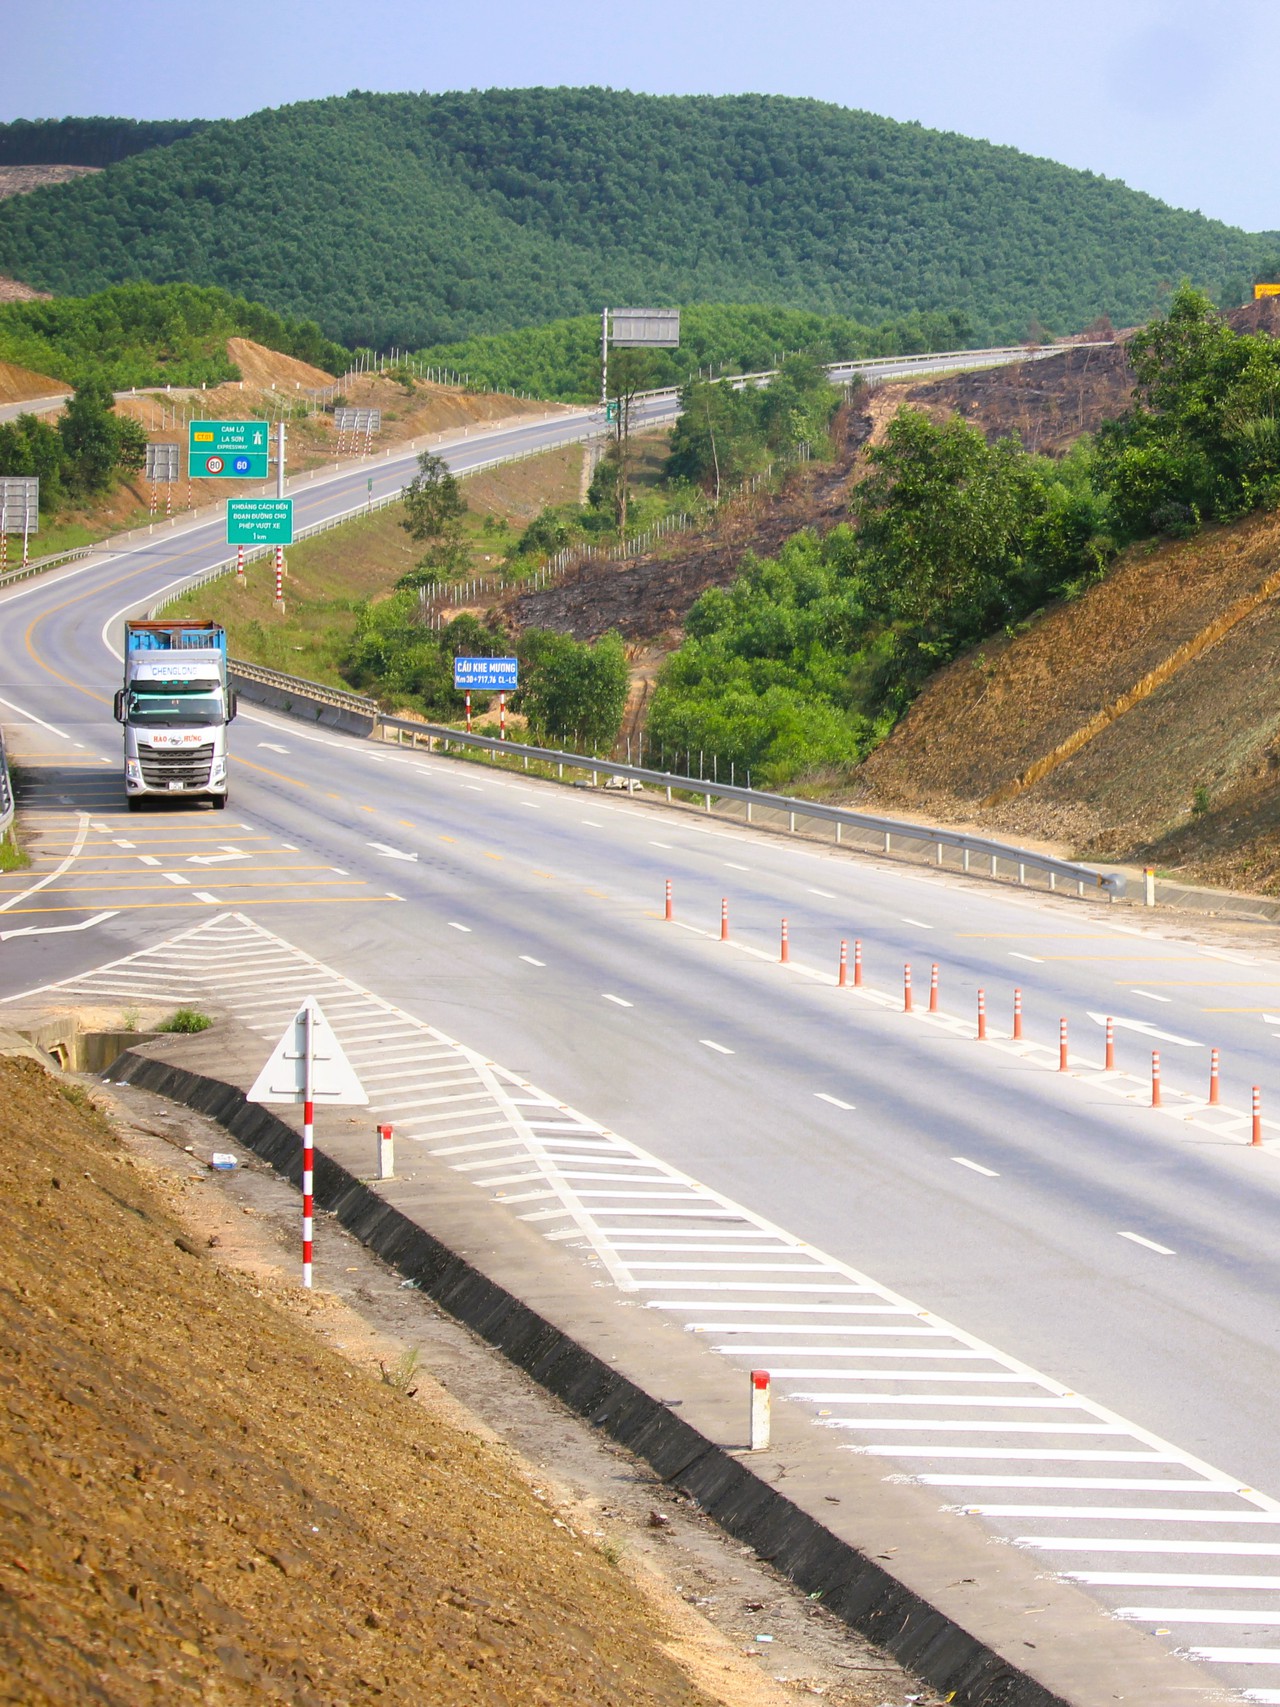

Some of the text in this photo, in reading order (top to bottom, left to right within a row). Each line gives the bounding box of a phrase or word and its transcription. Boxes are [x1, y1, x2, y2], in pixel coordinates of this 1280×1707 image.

[210, 461, 221, 470] 80
[236, 461, 247, 470] 60
[152, 666, 197, 676] CHENGLONG
[473, 663, 488, 673] KHE
